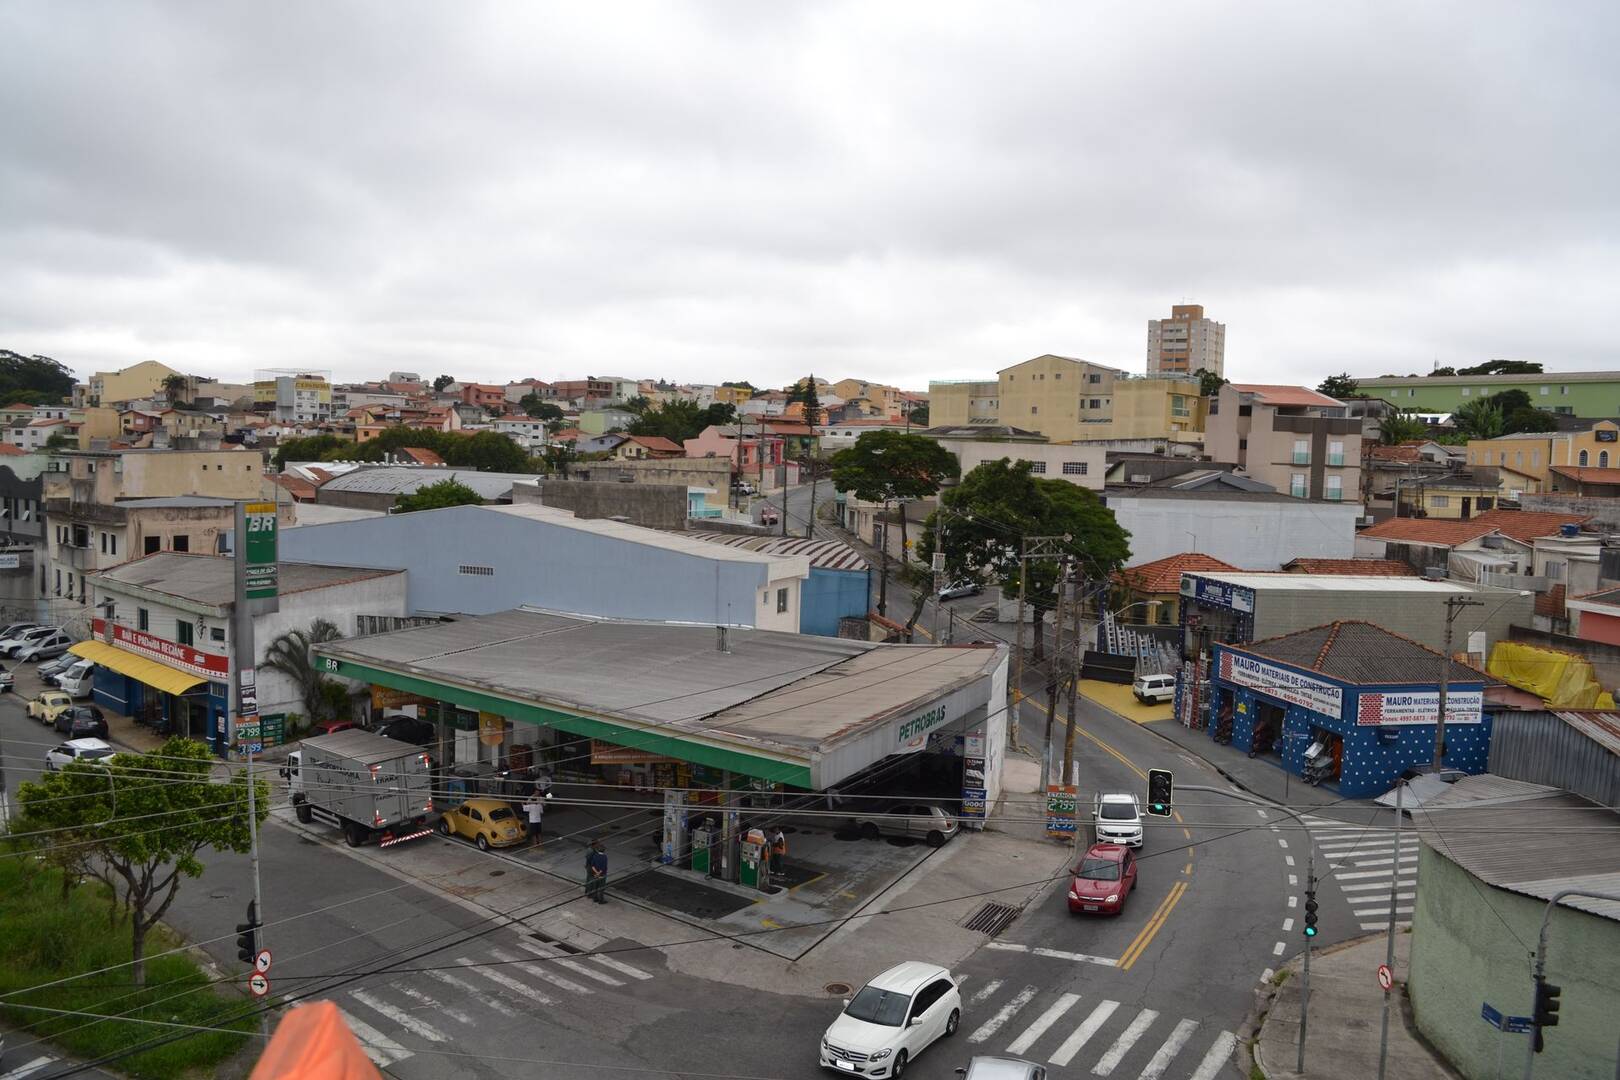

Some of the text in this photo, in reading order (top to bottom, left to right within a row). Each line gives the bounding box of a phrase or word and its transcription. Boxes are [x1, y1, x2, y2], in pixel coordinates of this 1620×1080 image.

[248, 516, 274, 532] BR
[326, 658, 338, 672] BR
[1233, 656, 1261, 674] MAURO
[1261, 667, 1290, 684] MATERIAIS
[1290, 675, 1299, 686] DE
[1386, 696, 1412, 706] MAURO
[1413, 697, 1440, 705] MATERIAIS
[898, 704, 947, 742] PETROBRAS
